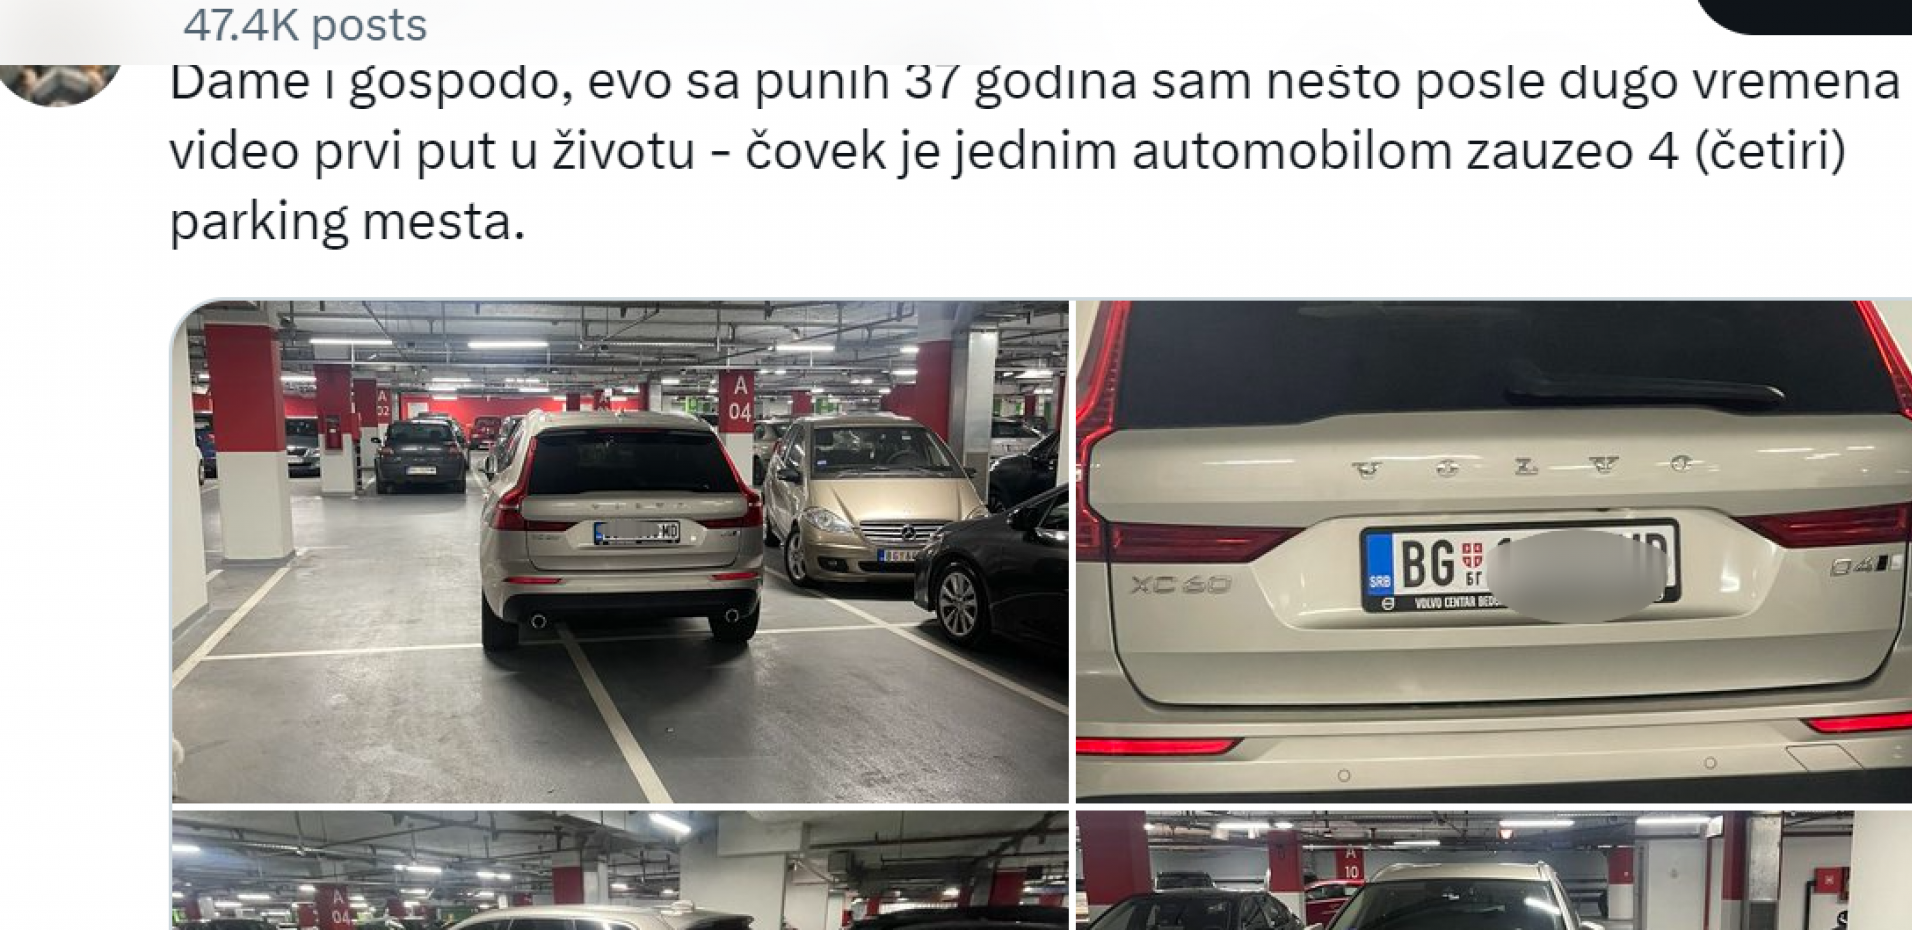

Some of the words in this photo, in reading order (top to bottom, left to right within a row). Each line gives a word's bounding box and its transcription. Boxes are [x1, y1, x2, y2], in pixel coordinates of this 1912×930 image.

[734, 375, 748, 395] A
[729, 402, 751, 423] 04
[1402, 539, 1455, 588] BG
[1369, 575, 1392, 588] SRB
[1415, 597, 1442, 609] VOLVO
[1444, 595, 1476, 608] CENTAR
[1344, 865, 1359, 878] 10
